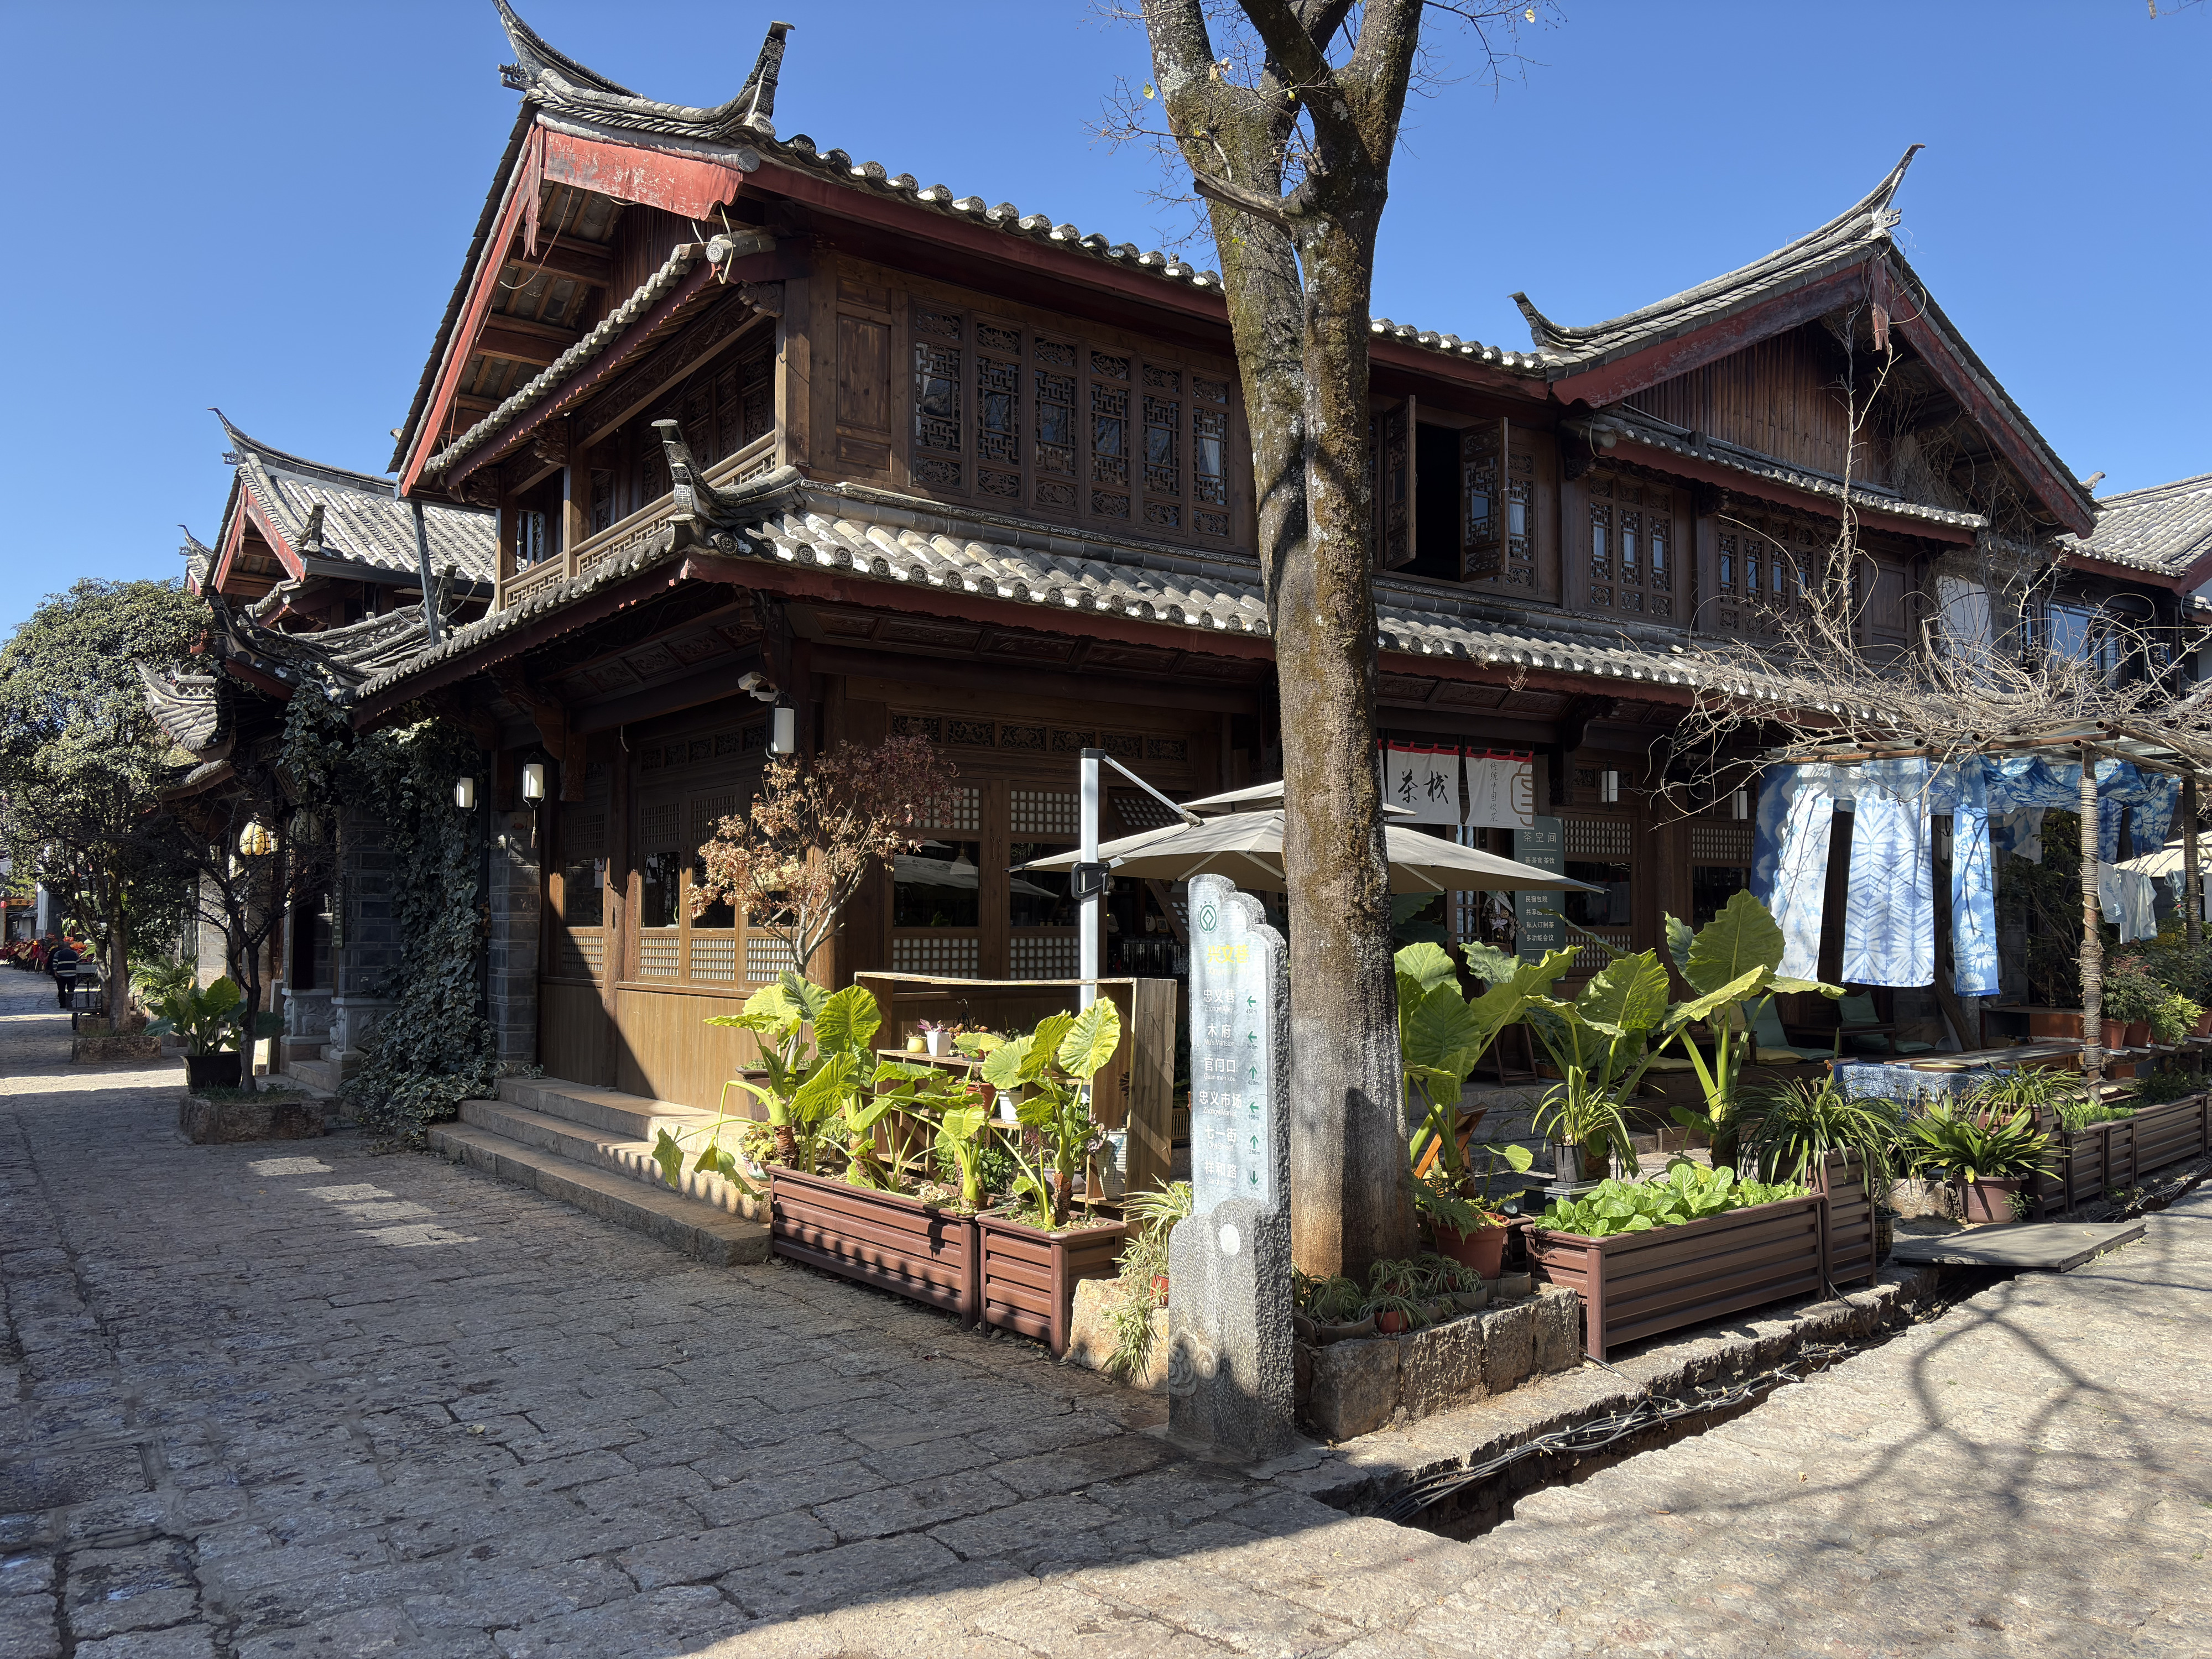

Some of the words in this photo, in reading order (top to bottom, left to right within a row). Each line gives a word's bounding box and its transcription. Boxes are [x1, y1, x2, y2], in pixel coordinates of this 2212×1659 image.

[1398, 769, 1449, 805] 茶栈
[1523, 831, 1556, 843] 茶空间
[1207, 943, 1249, 964] 兴文巷
[1203, 988, 1235, 1004] 忠义巷
[1204, 1005, 1222, 1013] Zhongyi
[1222, 1005, 1233, 1014] Alley
[1207, 1022, 1232, 1039] 木府
[1204, 1056, 1235, 1073] 官门口
[1199, 1089, 1242, 1109] 忠义市场
[1203, 1107, 1220, 1117] Zhongyi
[1221, 1108, 1237, 1117] Market
[1204, 1124, 1237, 1143] 七一街
[1207, 1141, 1218, 1150] Qiyi
[1218, 1142, 1234, 1151] Street
[1204, 1159, 1237, 1180] 祥和路
[1206, 1176, 1224, 1186] Xianghe
[1224, 1180, 1237, 1188] Road
